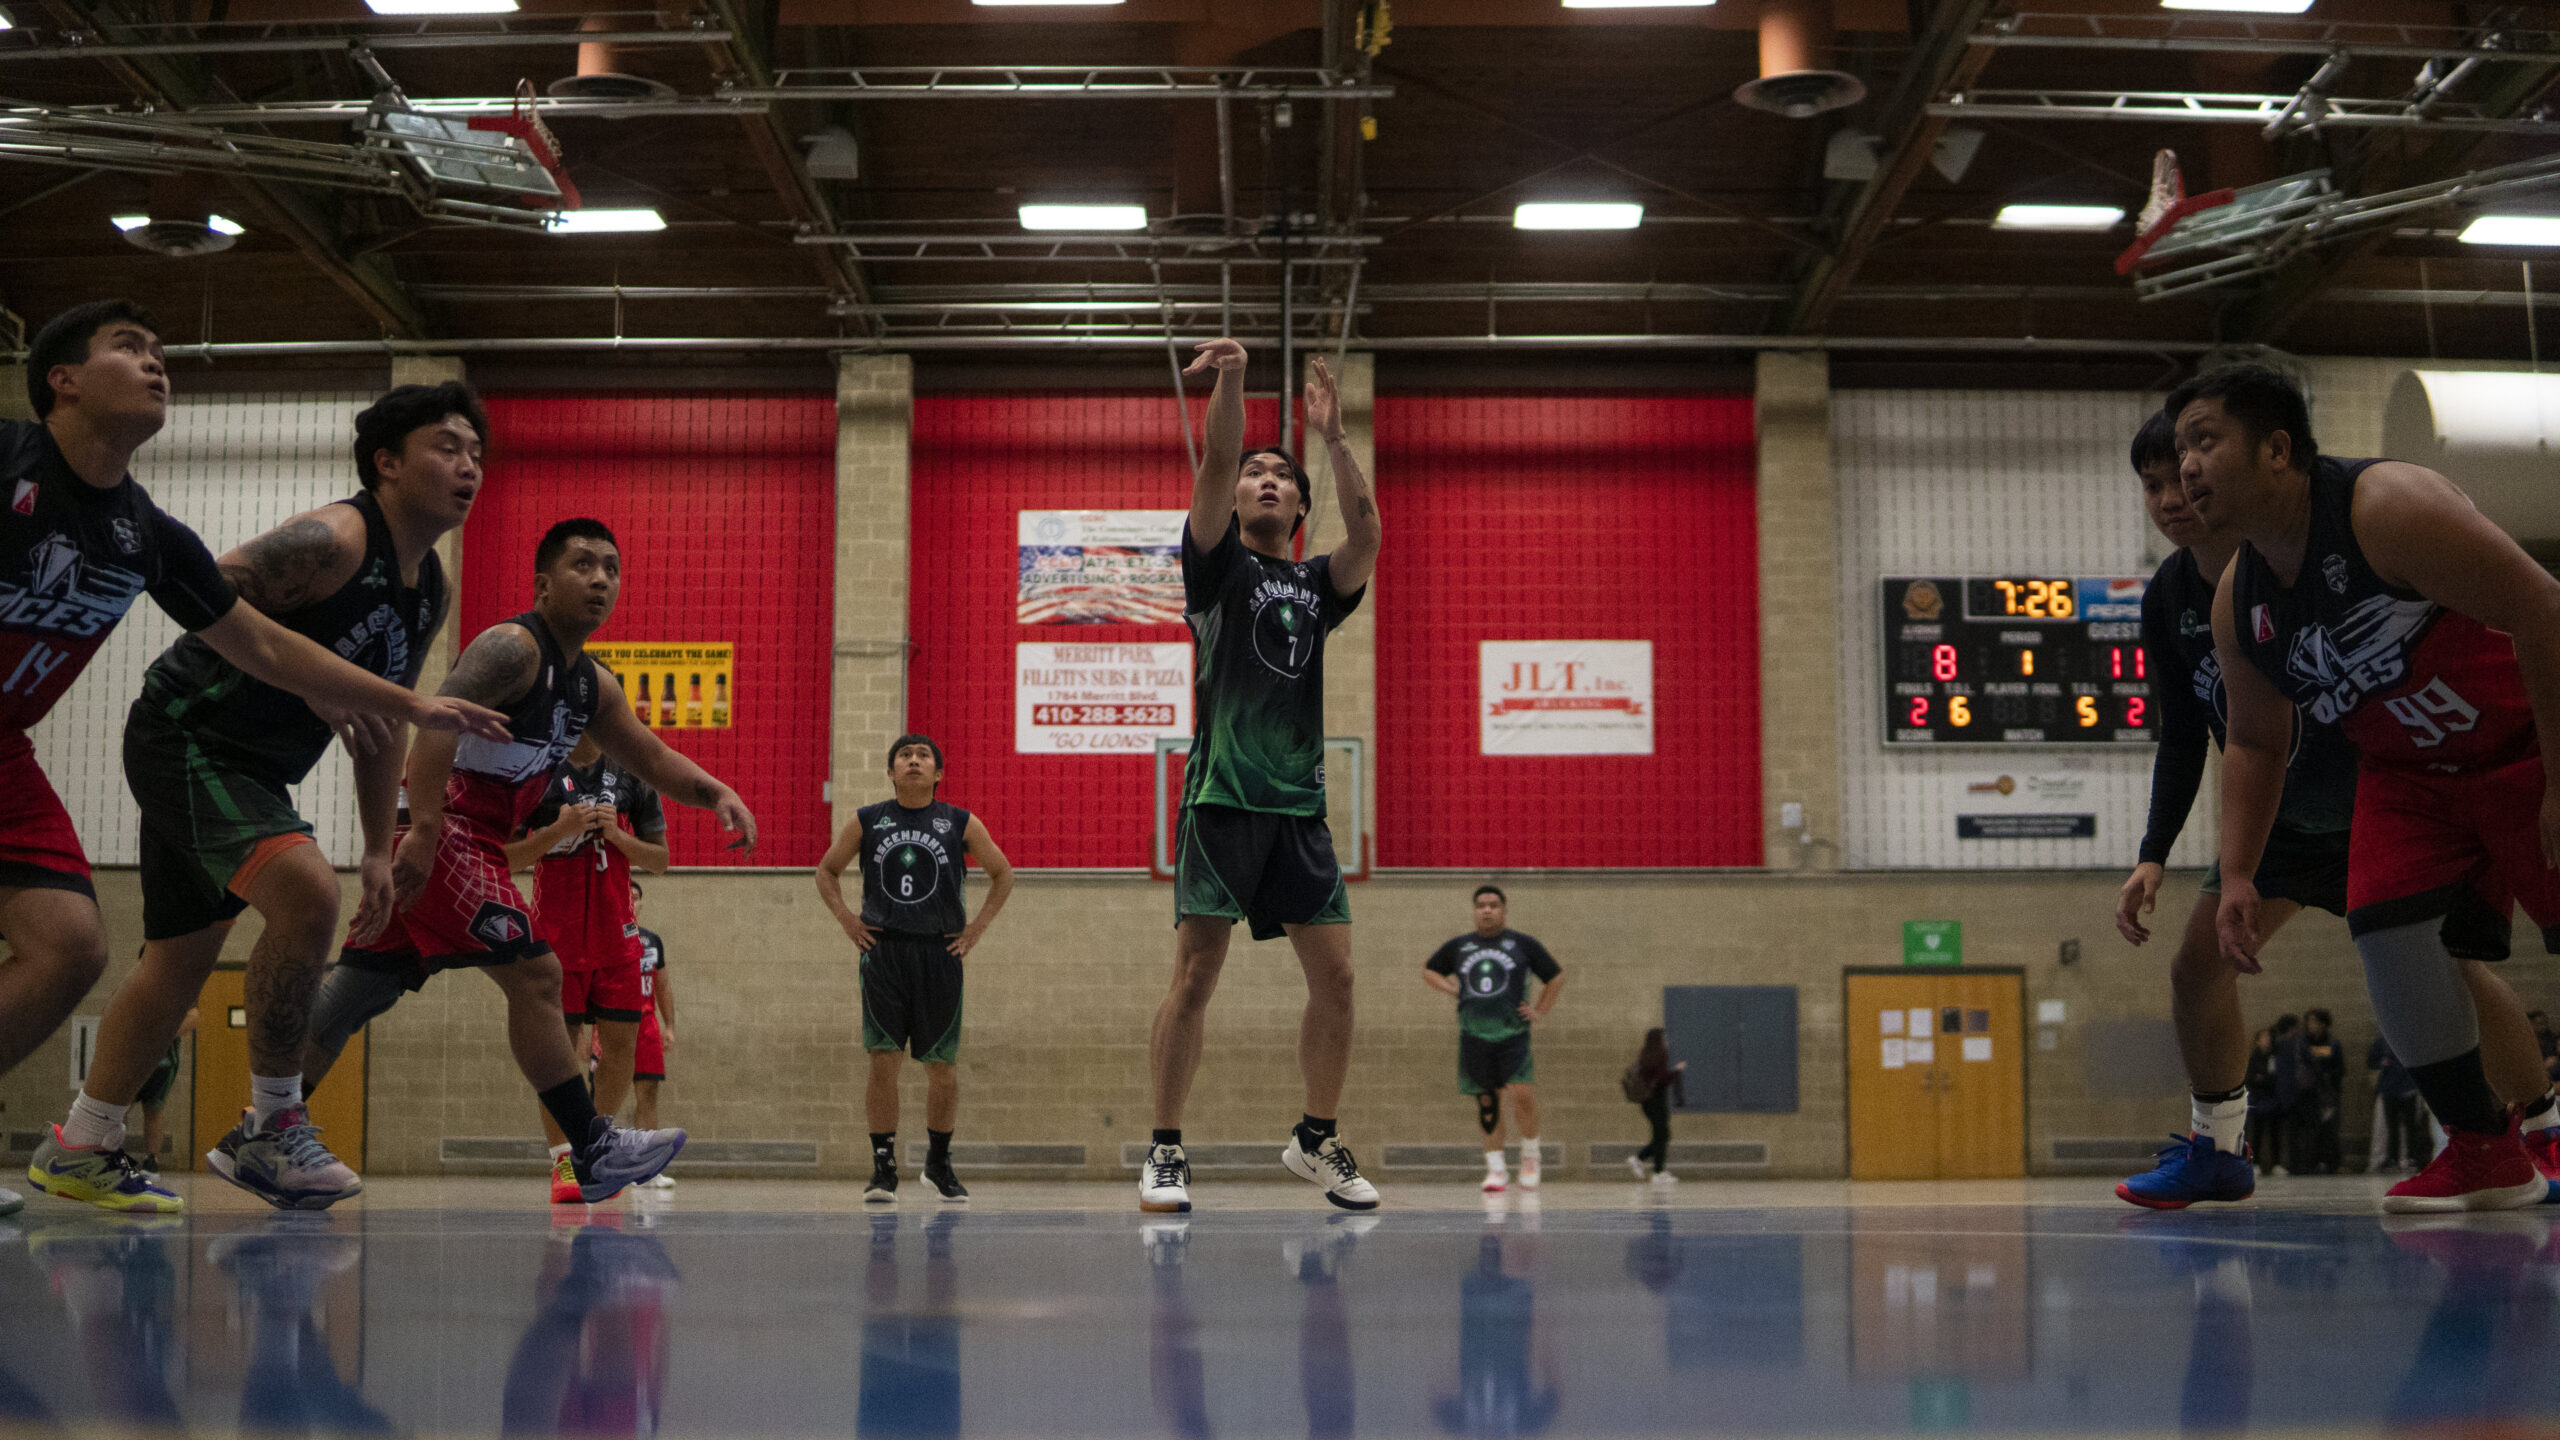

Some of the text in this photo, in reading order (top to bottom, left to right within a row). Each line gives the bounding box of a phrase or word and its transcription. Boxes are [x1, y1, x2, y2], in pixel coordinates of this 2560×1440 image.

[1086, 557, 1173, 568] ATHLETICS
[1024, 573, 1116, 584] ADVERTISING
[1994, 580, 2073, 619] 7:26
[615, 649, 632, 659] YOU
[634, 649, 683, 659] CELEBRATE
[686, 649, 703, 659] THE
[1054, 646, 1155, 663] MERRITT PARK
[1288, 635, 1298, 667] 7
[1933, 644, 1957, 682] 8
[2021, 649, 2034, 676] 1
[2111, 647, 2145, 679] 11
[2, 641, 70, 696] 14
[1092, 669, 1127, 686] SUBS
[1131, 669, 1141, 686] &
[1145, 669, 1185, 686] PIZZA
[1082, 691, 1125, 700] Merritt
[2312, 653, 2405, 725] ACES
[1036, 707, 1172, 723] 410-288-5628
[1909, 696, 2146, 727] 2 6 5 2
[2383, 675, 2480, 748] 99
[901, 874, 913, 897] 6
[1481, 977, 1492, 993] 0
